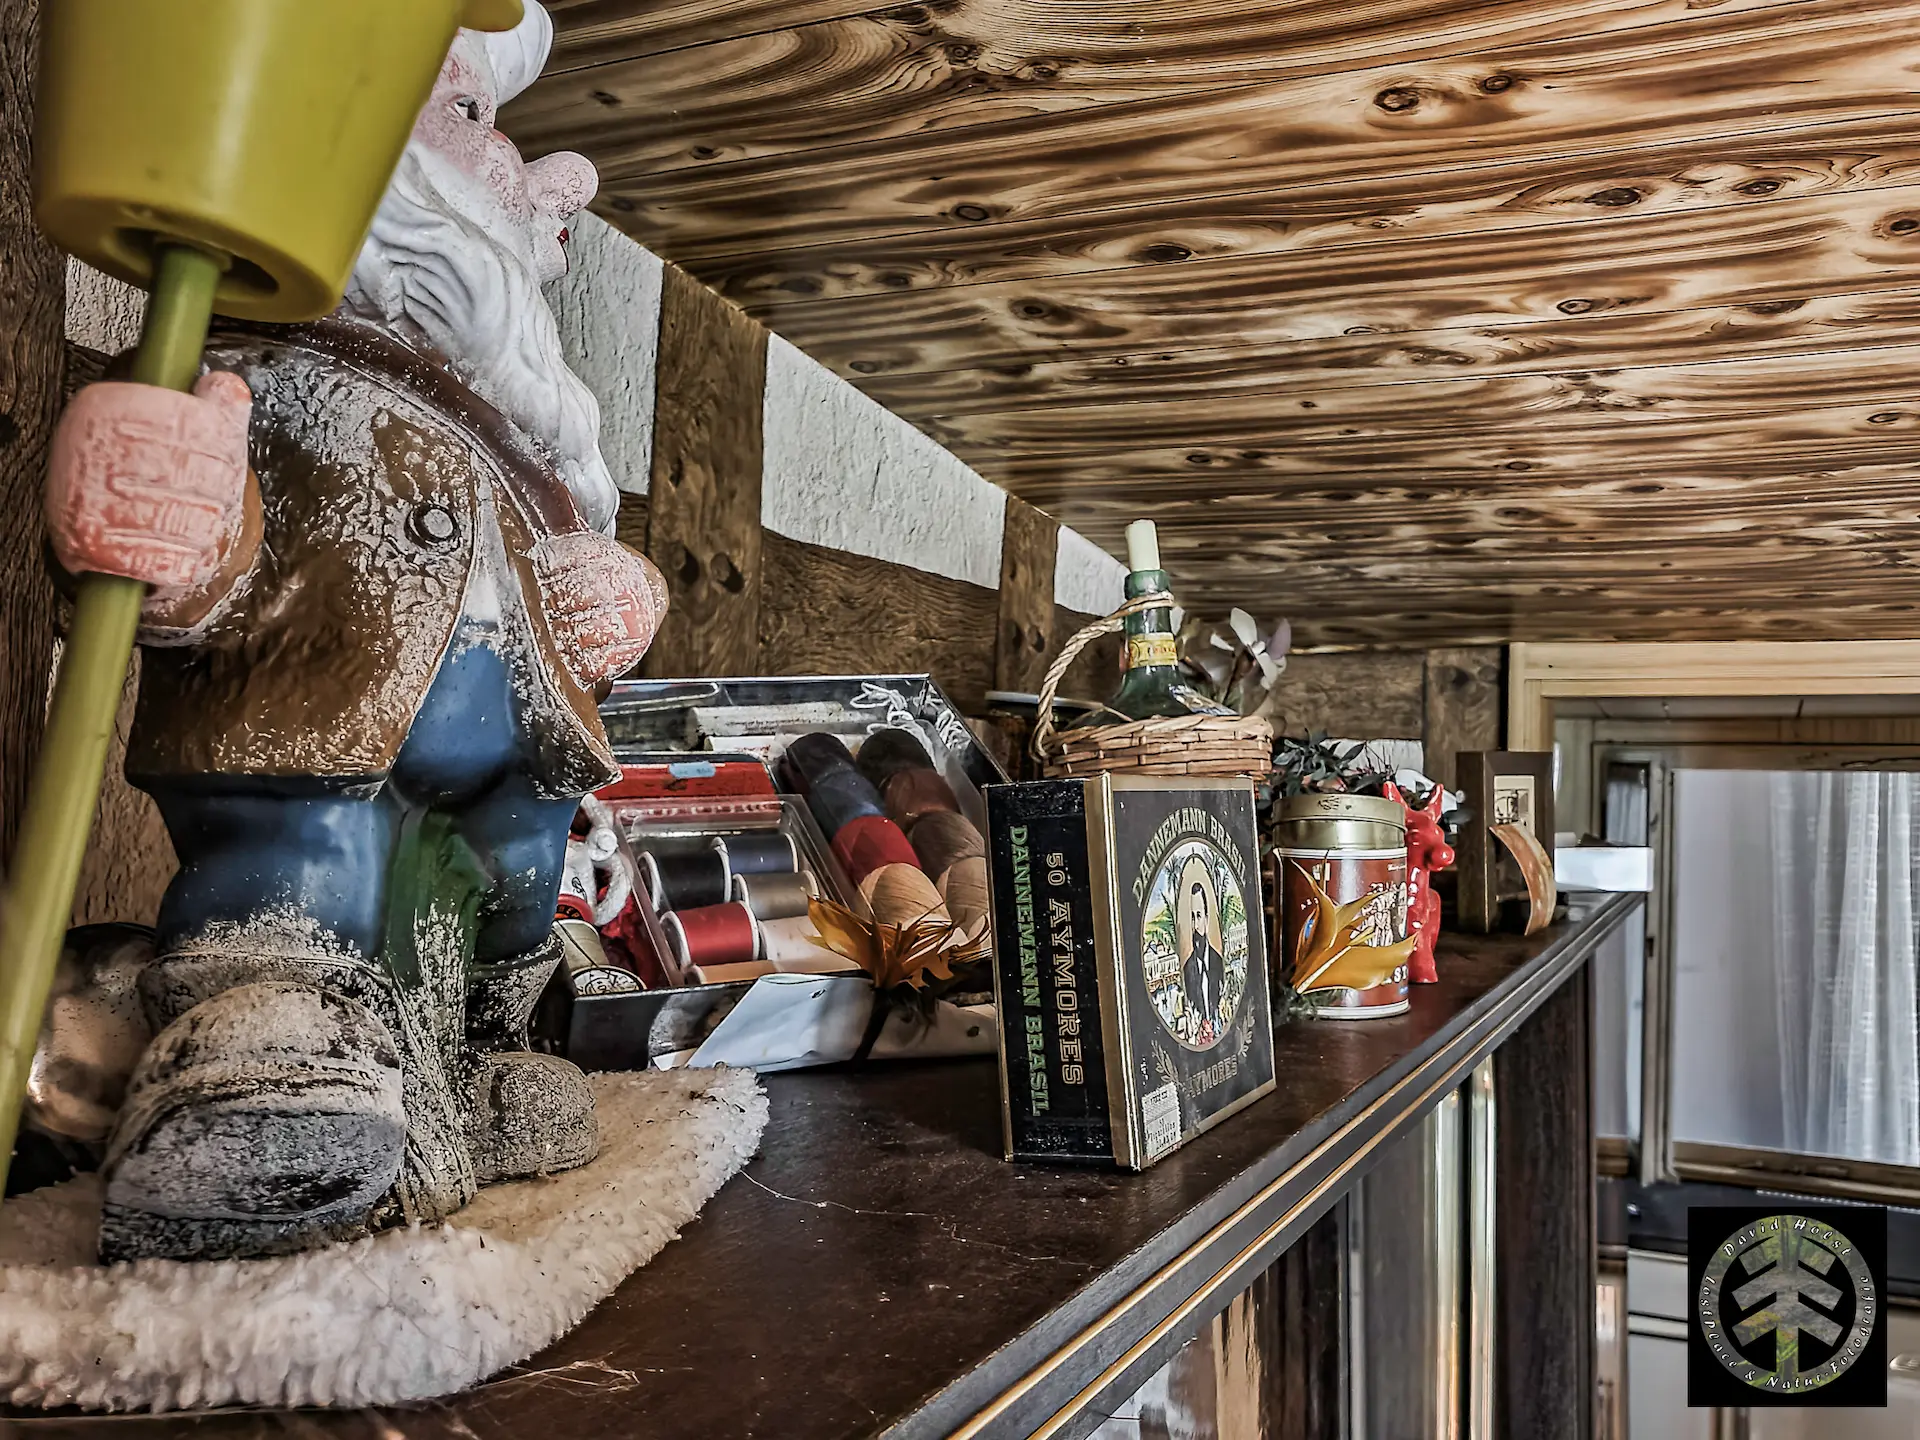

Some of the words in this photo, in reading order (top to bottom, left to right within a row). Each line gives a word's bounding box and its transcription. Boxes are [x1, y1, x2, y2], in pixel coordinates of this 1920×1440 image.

[1046, 852, 1066, 886] 50
[1132, 806, 1207, 908] DANNEMANN
[1210, 814, 1246, 888] BRASIL
[1010, 824, 1041, 1008] DANNEMANN
[1049, 898, 1084, 1085] AYMORES
[1025, 1014, 1050, 1117] BRASIL
